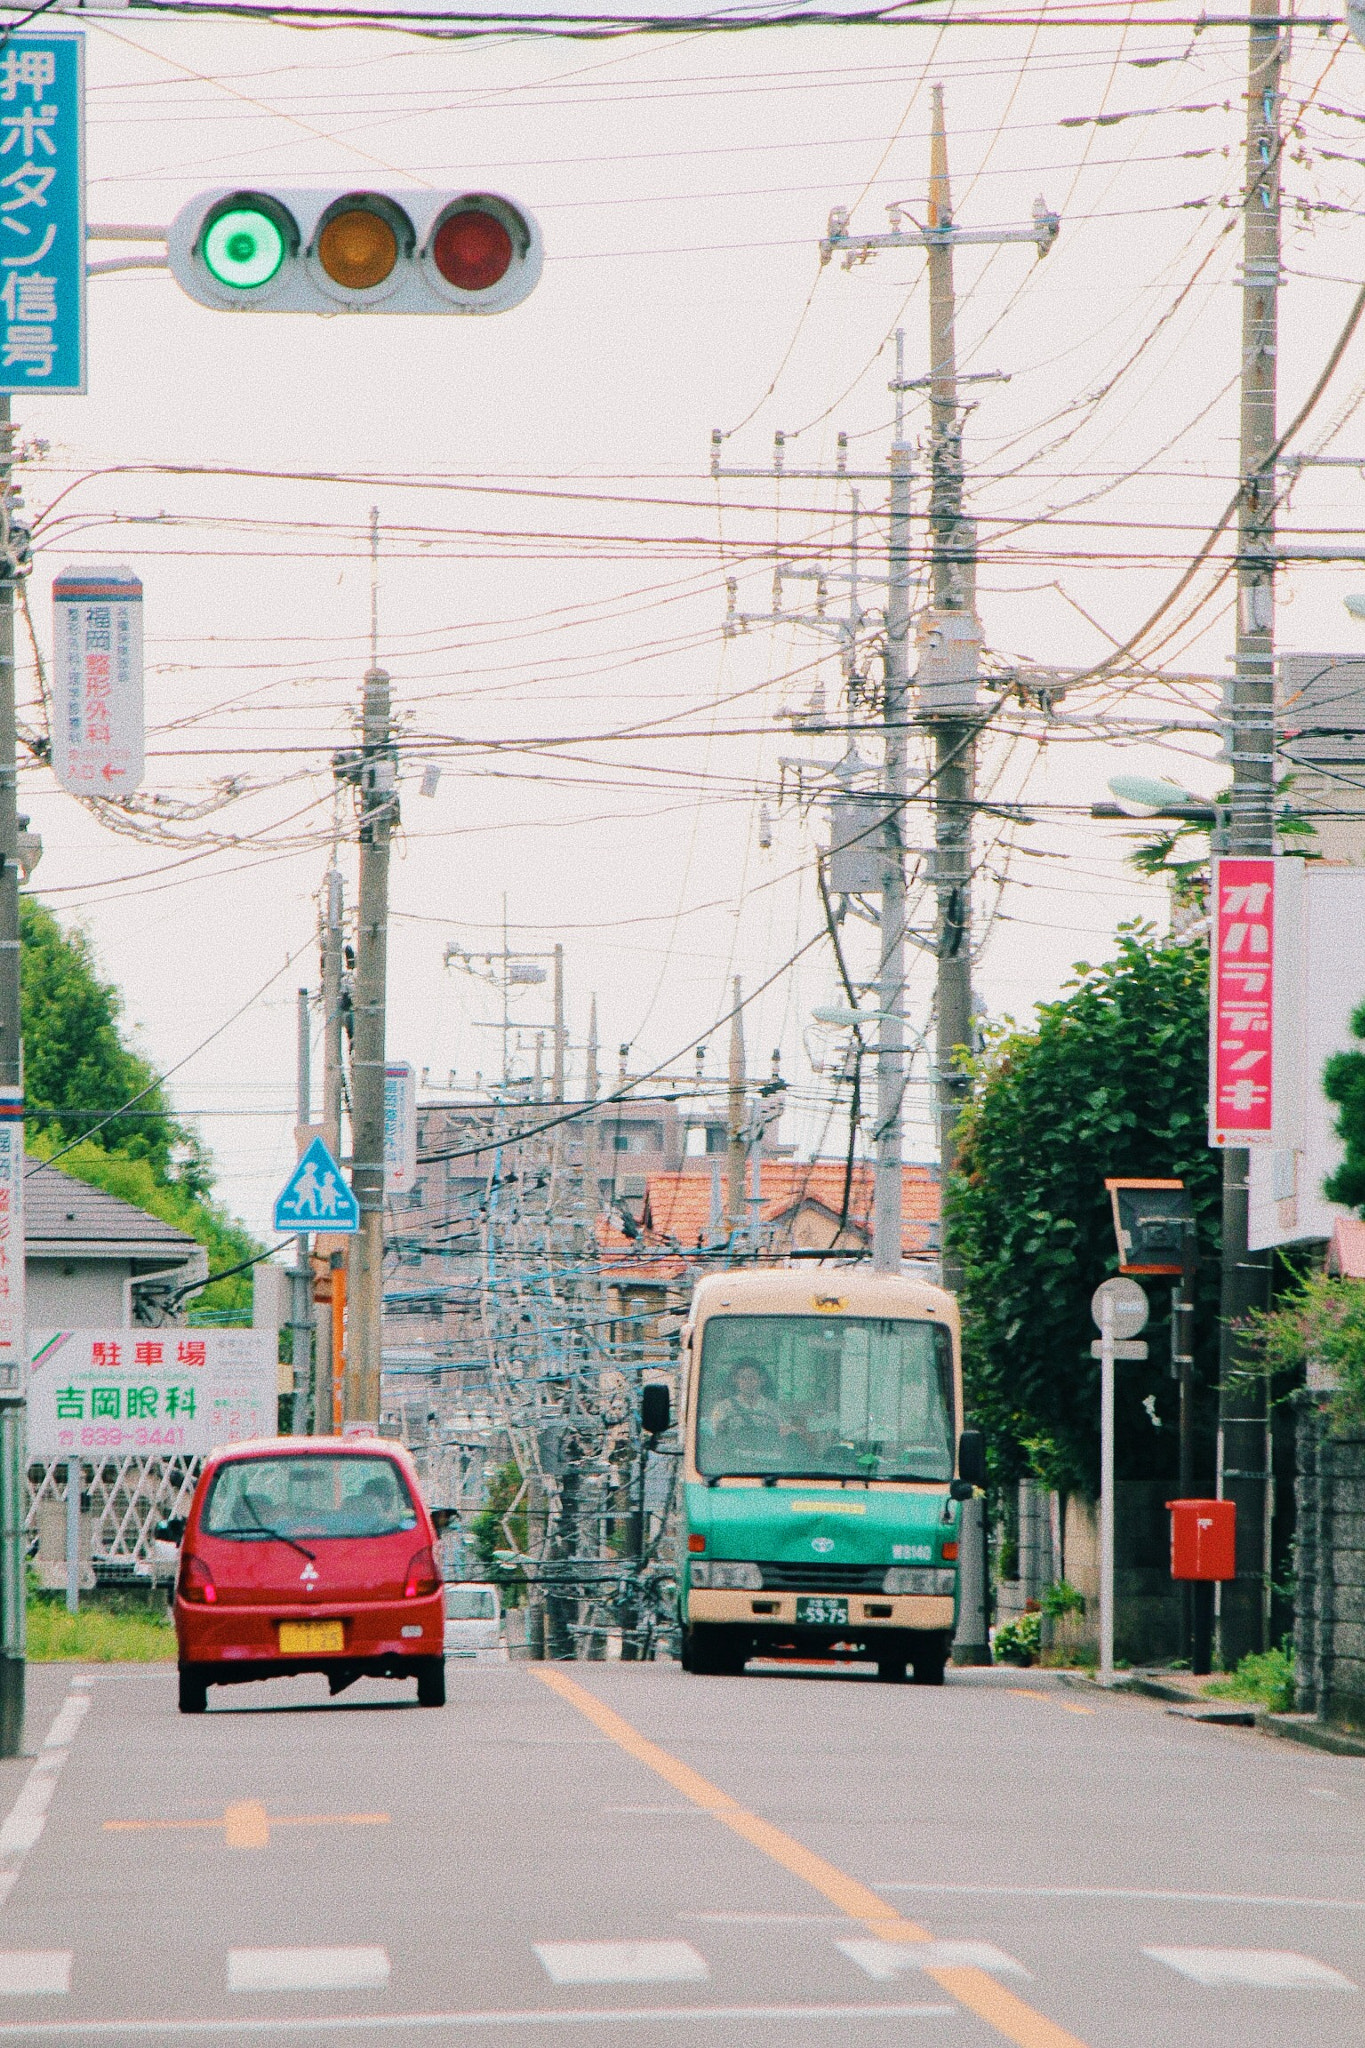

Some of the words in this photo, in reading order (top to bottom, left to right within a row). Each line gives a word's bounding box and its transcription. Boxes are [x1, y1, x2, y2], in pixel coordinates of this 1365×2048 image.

[0, 50, 58, 376] 押ボタン信号
[1220, 882, 1272, 1111] オハラデンキ
[56, 1385, 196, 1420] 吉岡眼科
[91, 1341, 206, 1367] 駐車場
